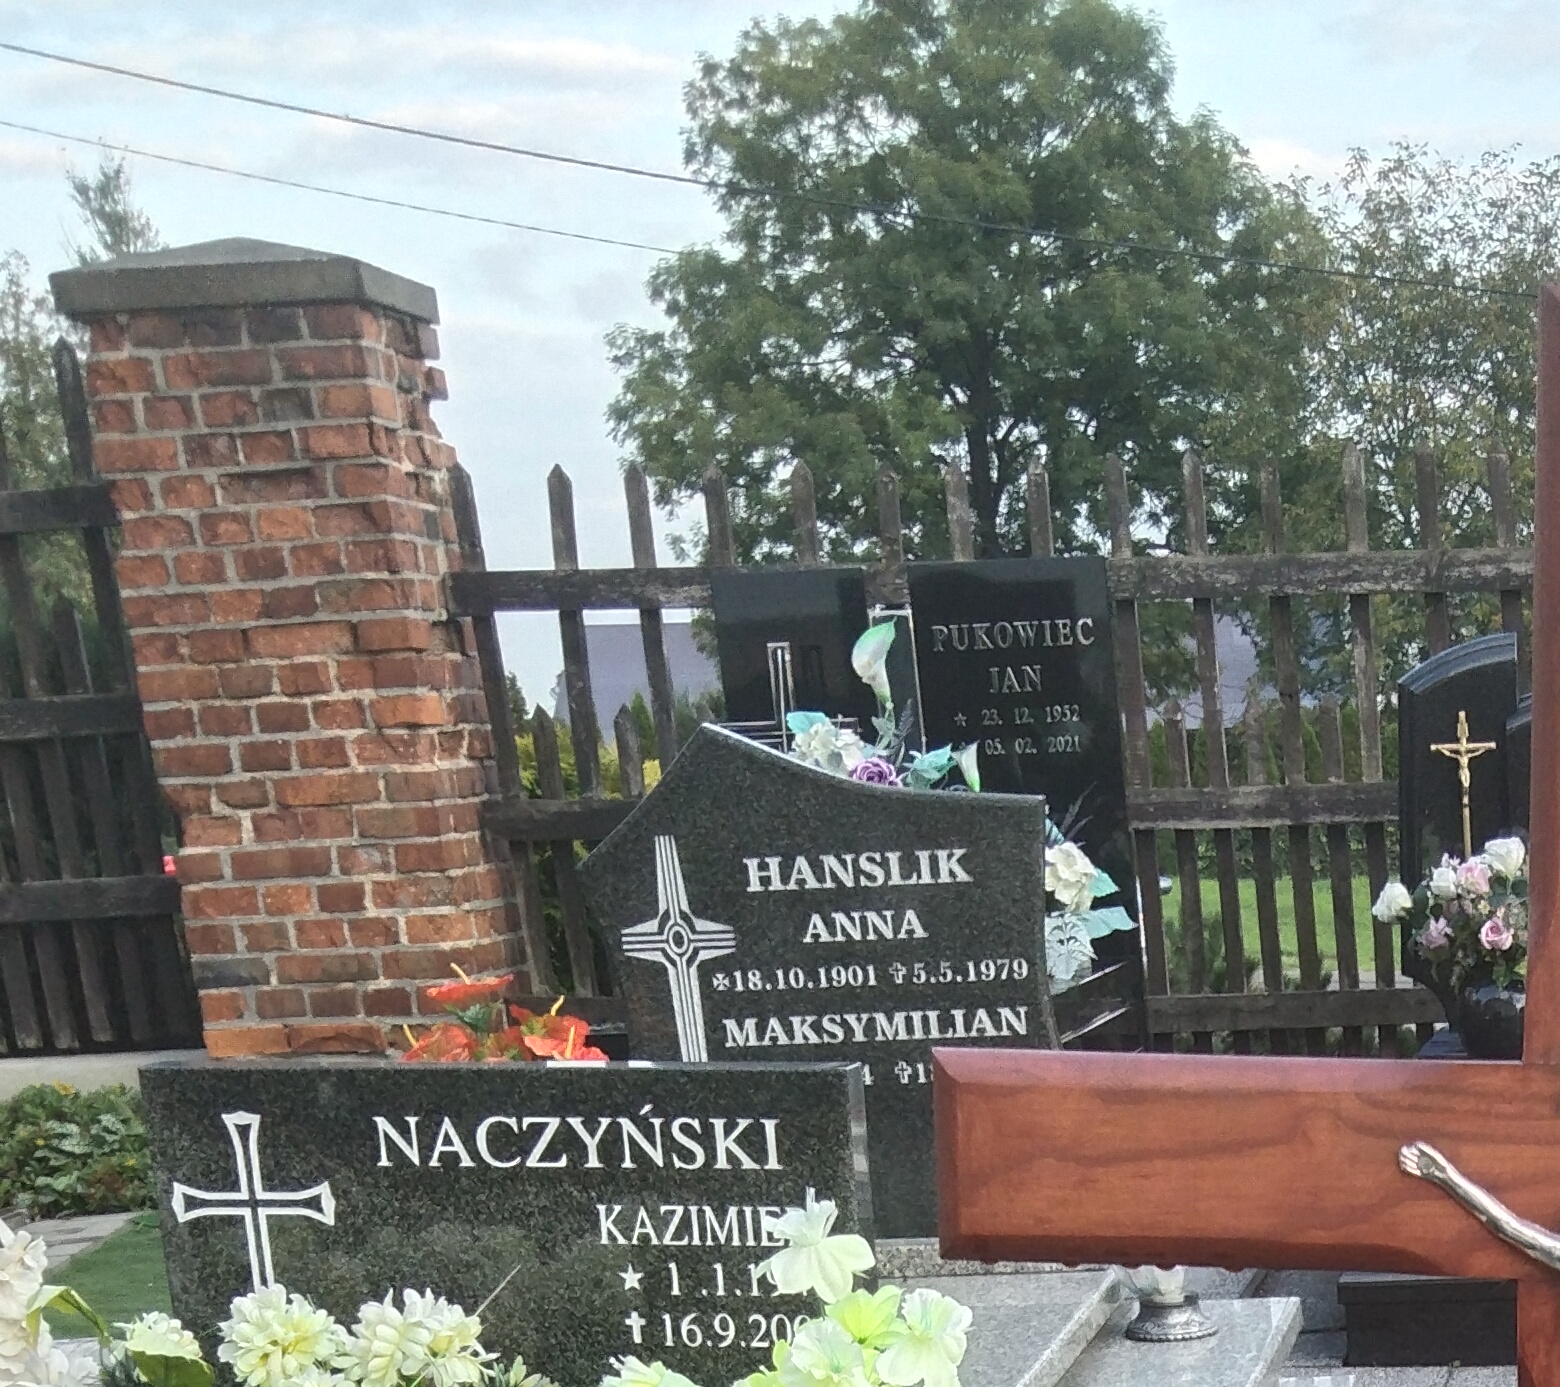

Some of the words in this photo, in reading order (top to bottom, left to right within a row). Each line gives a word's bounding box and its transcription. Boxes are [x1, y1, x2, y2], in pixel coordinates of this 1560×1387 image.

[931, 617, 1095, 652] PUKOWIEC
[988, 664, 1042, 694] JAN
[1045, 704, 1081, 723] 1952
[1047, 735, 1081, 753] 2021
[743, 848, 975, 893] HANSLIK
[802, 909, 930, 944] ANNA
[722, 1005, 1029, 1049] MAKSYMILIAN
[373, 1104, 784, 1171] NACZYŃSKI
[596, 1203, 805, 1247] KAZIMIE
